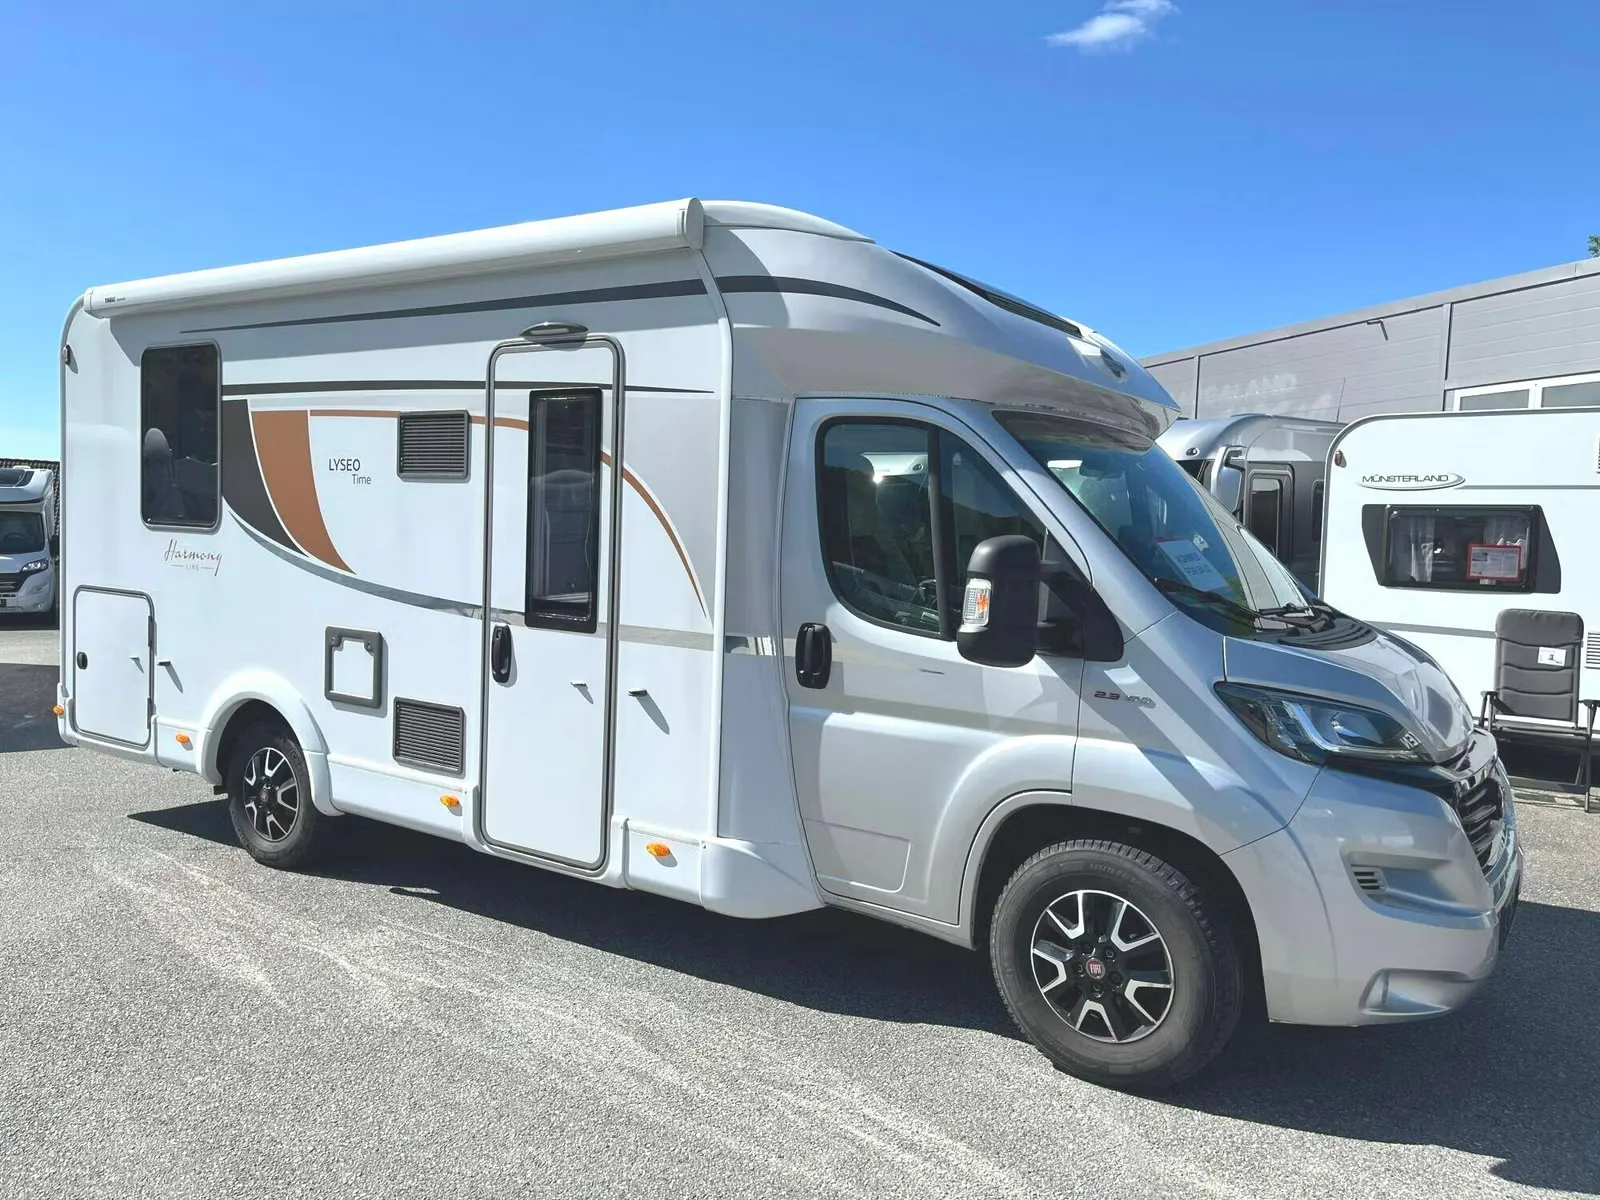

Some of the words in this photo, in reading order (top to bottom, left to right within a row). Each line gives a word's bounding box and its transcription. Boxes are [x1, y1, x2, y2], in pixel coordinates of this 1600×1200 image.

[328, 458, 361, 472] LYSEO
[351, 473, 372, 485] Time
[1361, 474, 1449, 483] MÜNSTERLAND
[164, 538, 223, 576] Harmony
[185, 563, 200, 571] LINE
